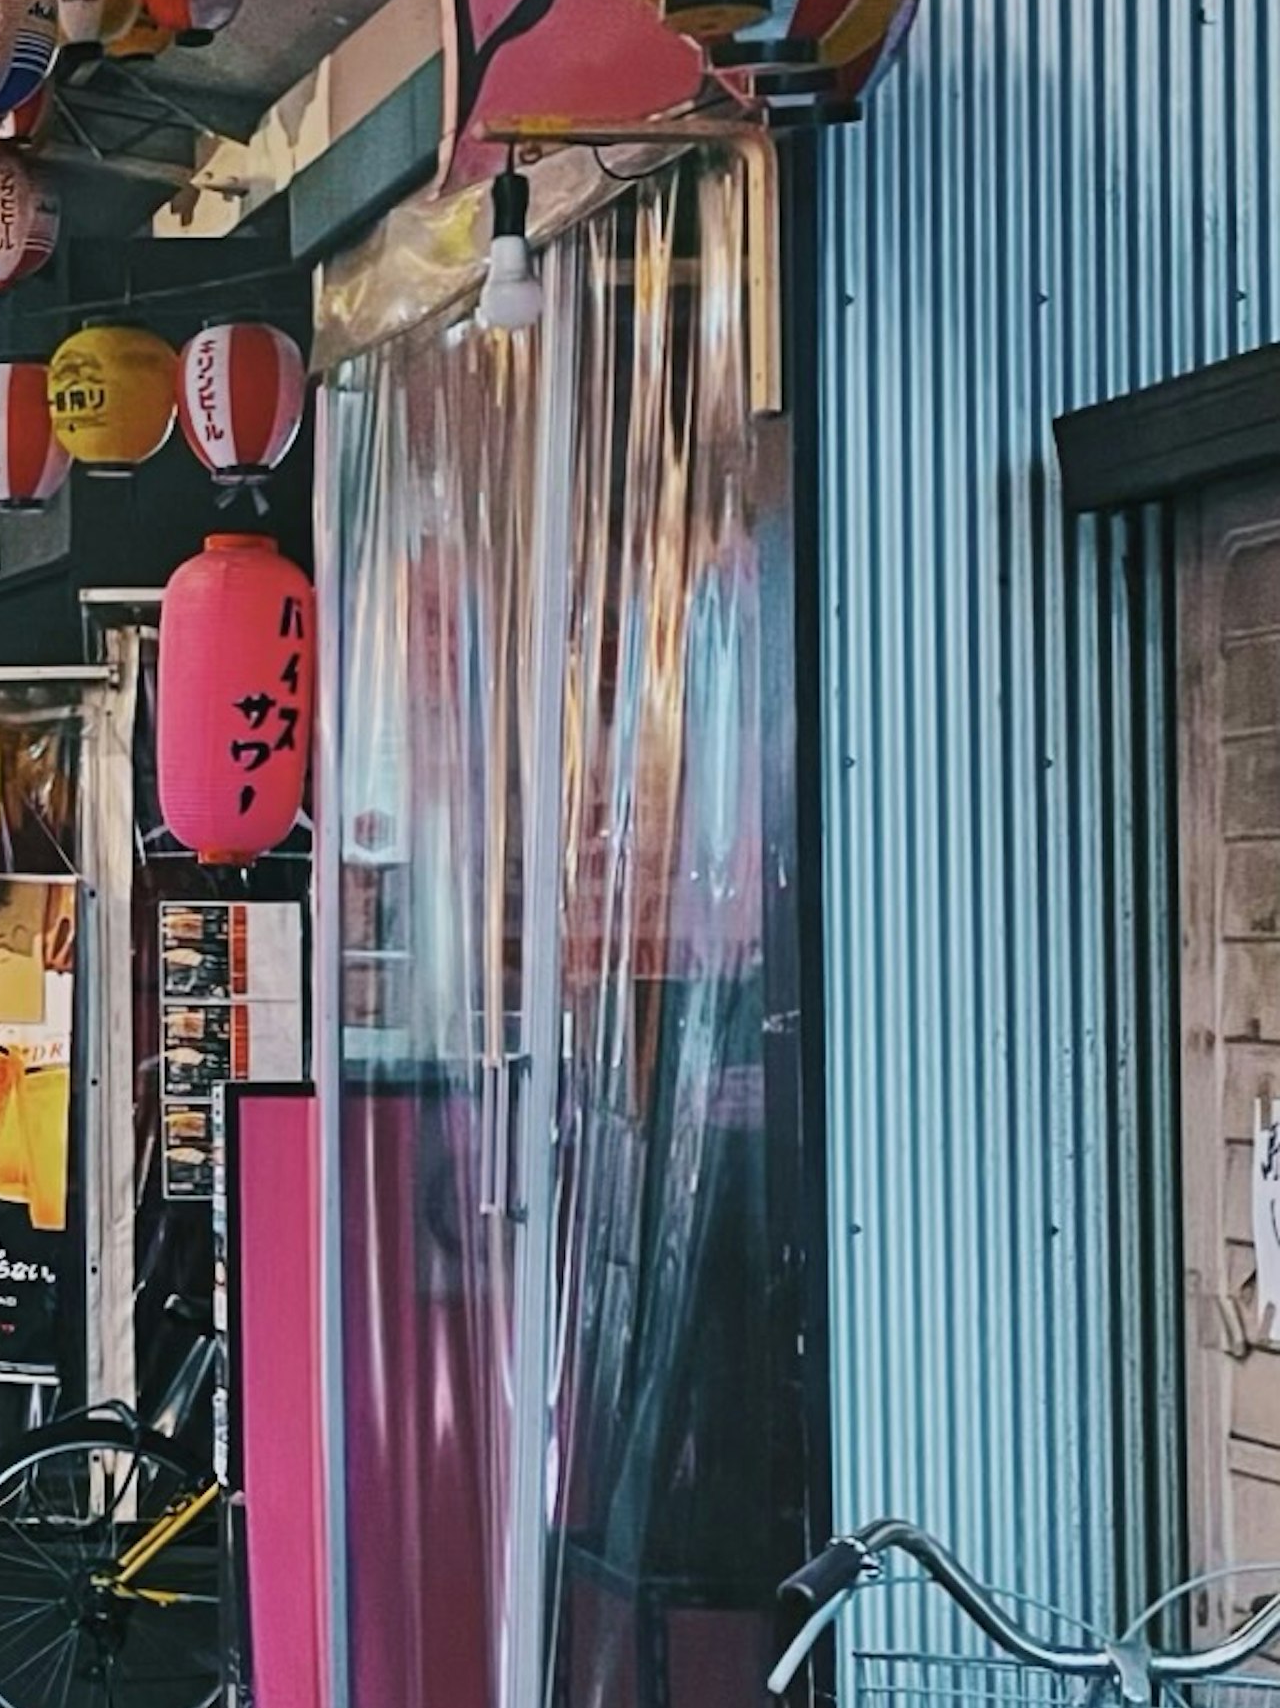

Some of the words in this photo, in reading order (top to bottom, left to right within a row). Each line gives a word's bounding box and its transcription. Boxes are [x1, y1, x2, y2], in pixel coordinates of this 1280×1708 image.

[198, 339, 225, 442] キリンビール
